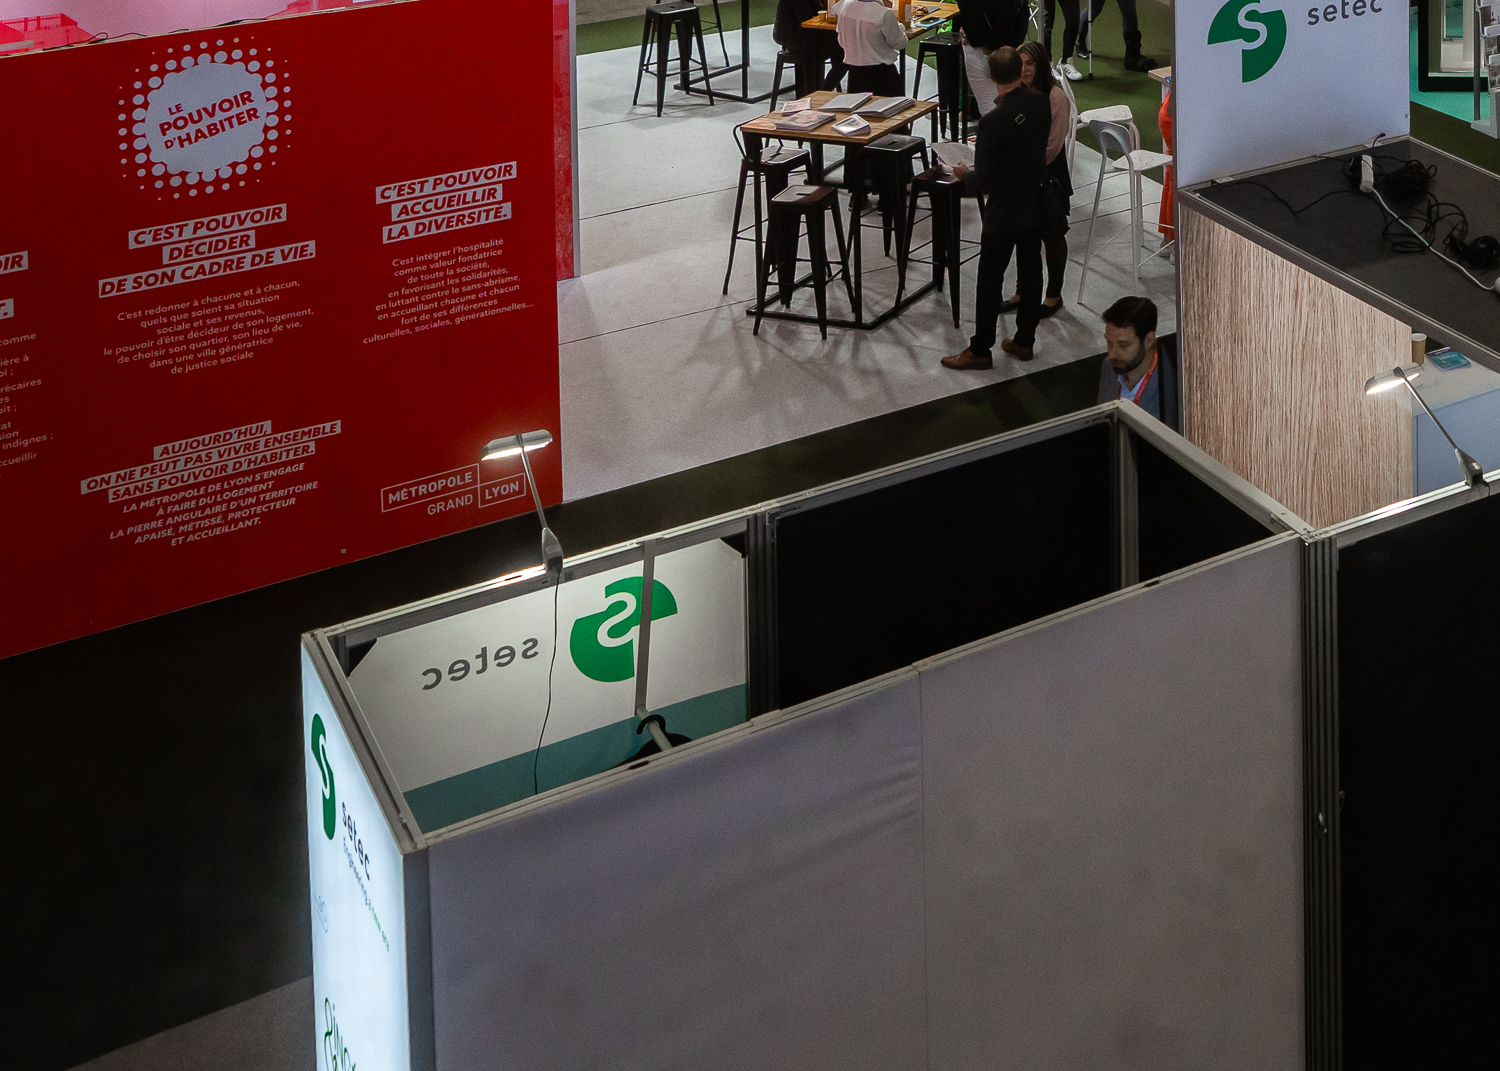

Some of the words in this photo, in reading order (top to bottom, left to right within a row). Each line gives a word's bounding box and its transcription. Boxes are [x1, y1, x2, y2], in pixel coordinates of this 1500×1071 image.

[159, 90, 255, 138] POUVOIR
[164, 107, 261, 150] D'HABITER
[168, 103, 184, 117] LE
[380, 179, 429, 201] C'EST
[432, 163, 514, 191] POUVOIR
[396, 186, 498, 219] ACCUEILLIR
[133, 222, 189, 246] C'EST
[192, 205, 284, 236] POUVOIR
[386, 224, 409, 242] LA
[413, 203, 508, 236] DIVERSITÉ.
[168, 232, 252, 263] DÉCIDER
[393, 256, 414, 267] C'est
[416, 249, 451, 263] intégrer
[453, 238, 504, 256] l'hospitalité
[100, 278, 128, 297] DE
[131, 268, 176, 291] SON
[180, 255, 247, 282] CADRE
[250, 250, 275, 269] DE
[280, 242, 315, 262] VIE.
[86, 477, 112, 491] ON
[115, 470, 136, 486] NE
[140, 459, 182, 477] PEUT
[183, 450, 213, 466] PAS
[217, 442, 261, 460] VIVRE
[263, 422, 338, 449] ENSEMBLE
[158, 423, 269, 459] AUJOURD'HUI,
[111, 483, 155, 502] SANS
[157, 463, 229, 490] POUVOIR
[231, 443, 315, 471] D'HABITER.
[388, 470, 473, 505] MÉTROPOLE
[427, 495, 474, 516] GRAND
[484, 479, 520, 499] LYON
[341, 801, 371, 881] setec
